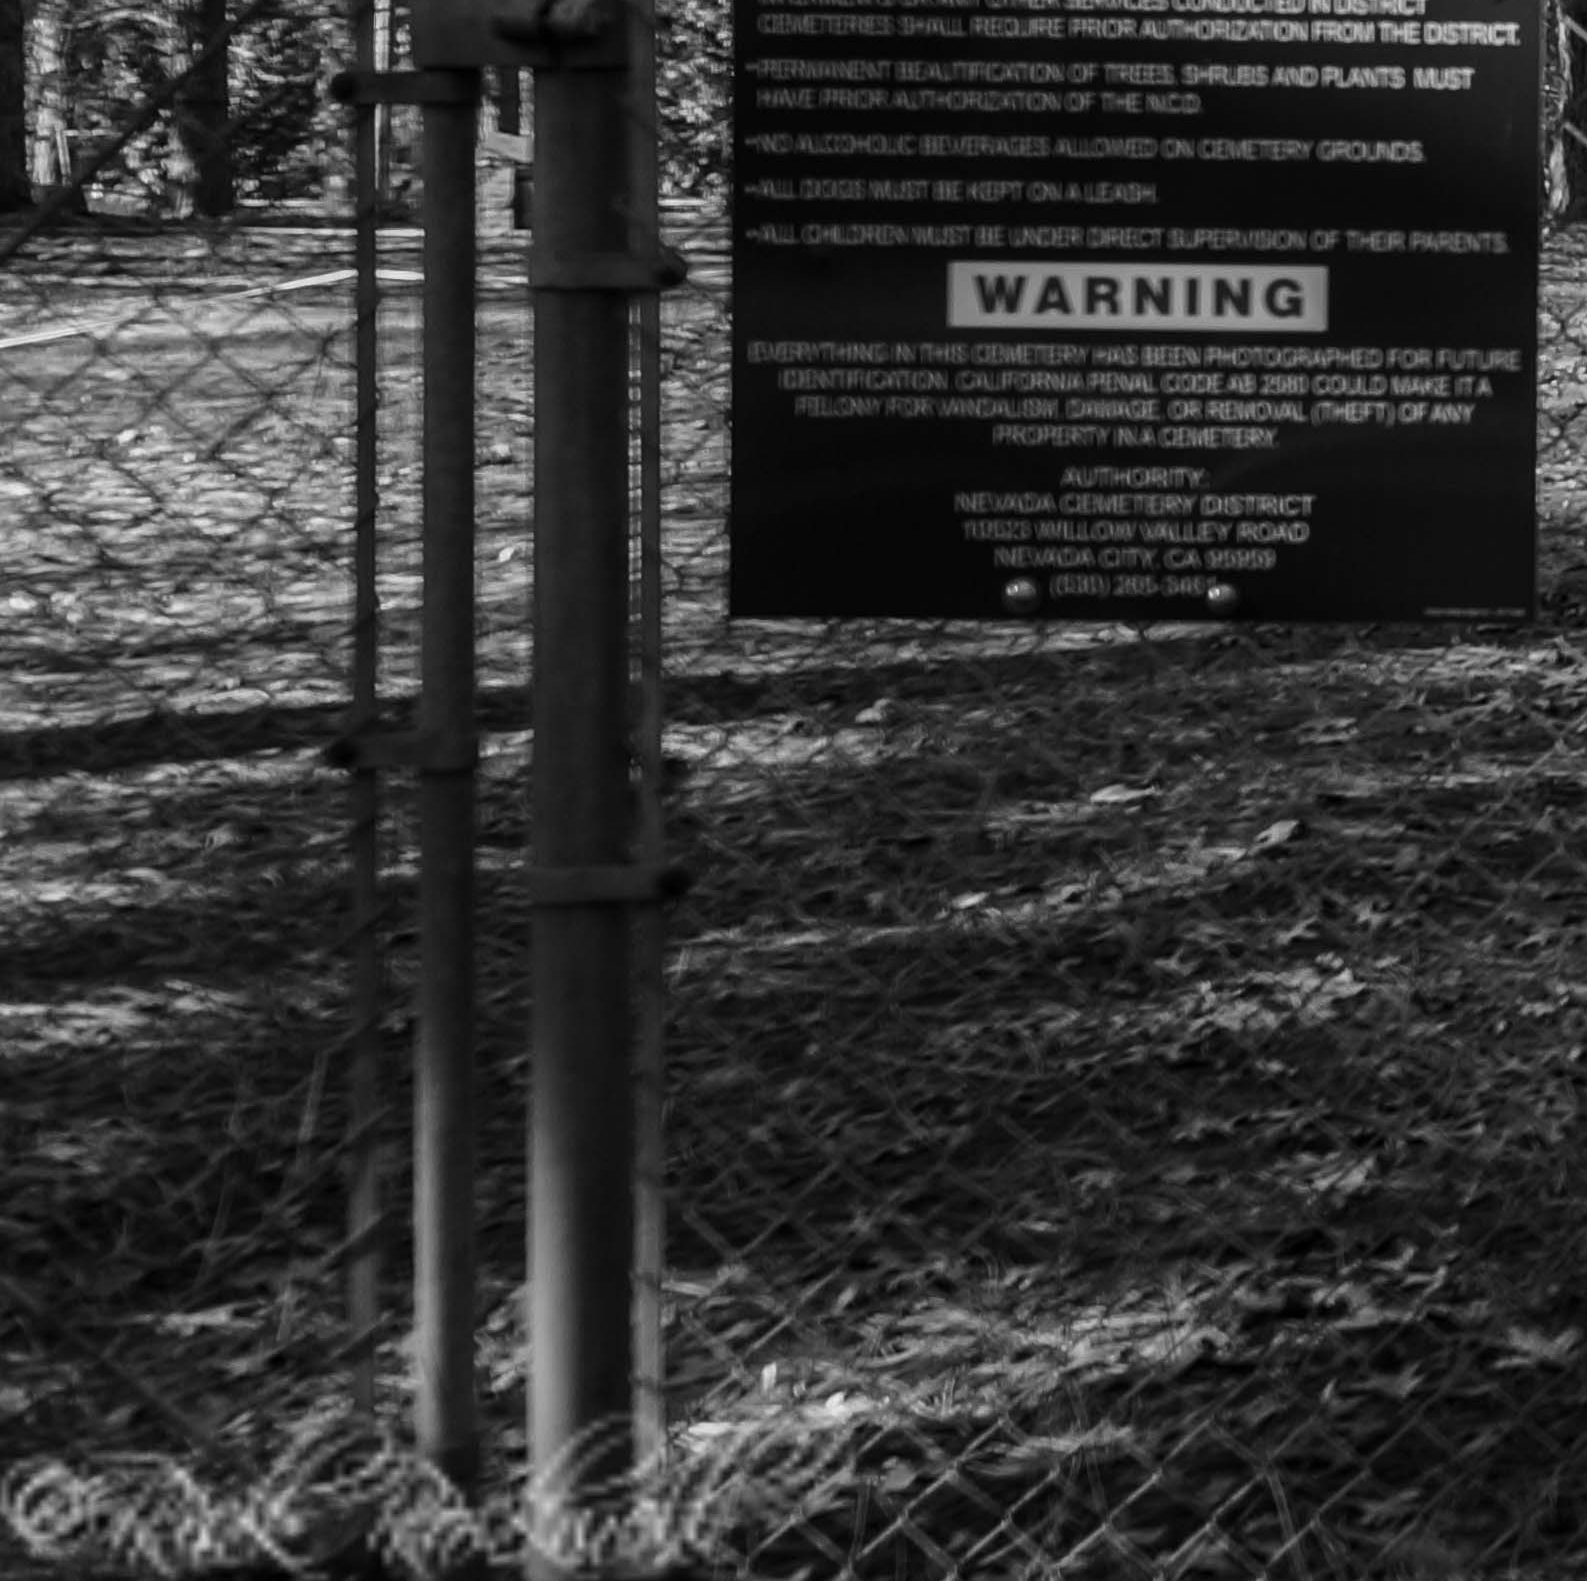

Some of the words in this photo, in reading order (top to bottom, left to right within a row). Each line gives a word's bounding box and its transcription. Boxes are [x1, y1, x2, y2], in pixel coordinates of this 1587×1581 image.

[756, 14, 895, 35] CEMETERIES
[896, 15, 966, 37] SHALL
[969, 16, 1067, 38] REQUIRE
[1068, 17, 1138, 39] PRIOR
[1138, 19, 1309, 41] AUTHORIZATION
[1310, 20, 1376, 43] FROM
[1378, 21, 1423, 44] THE
[895, 61, 1063, 82] BEAUTIFICATION
[1065, 62, 1097, 84] OF
[1179, 64, 1270, 86] SHRUBS
[1271, 65, 1319, 87] AND
[1320, 66, 1406, 88] PLANTS
[1412, 67, 1476, 90] MUST
[755, 87, 819, 108] HAVE
[818, 88, 891, 109] PRIOR
[890, 90, 1063, 111] AUTHORIZATION
[1063, 91, 1097, 113] OF
[1100, 91, 1144, 113] THE
[793, 134, 918, 155] ALCOHOLIC
[919, 135, 1051, 157] BEVERAGES
[1054, 137, 1159, 158] ALLOWED
[1160, 138, 1196, 159] ON
[1196, 139, 1314, 160] CEMETERY
[799, 179, 865, 200] DOGS
[867, 179, 931, 201] MUST
[932, 180, 963, 201] BE
[966, 181, 1024, 202] KEPT
[1025, 181, 1063, 202] ON
[1064, 182, 1082, 203] A
[800, 224, 910, 246] CHILDREN
[910, 225, 973, 247] MUST
[974, 225, 1007, 247] BE
[1008, 226, 1083, 248] UNDER
[1085, 227, 1165, 249] DIRECT
[1165, 228, 1307, 250] SUPERVISION
[1309, 229, 1341, 251] OF
[1344, 230, 1408, 252] THEIR
[973, 273, 1306, 318] WARNING
[746, 341, 891, 362] EVERYTHING
[892, 342, 917, 363] IN
[918, 342, 970, 364] THIS
[970, 343, 1087, 365] CEMETERY
[1090, 344, 1139, 366] HAS
[1141, 345, 1201, 367] BEEN
[1203, 346, 1384, 368] PHOTOGRAPHED
[1385, 348, 1434, 370] FOR
[1435, 348, 1522, 371] FUTURE
[953, 370, 1089, 392] CALIFORNIA
[1088, 371, 1159, 393] PENAL
[1160, 372, 1226, 394] CODE
[1310, 374, 1388, 396] COULD
[1389, 375, 1452, 397] MAKE
[1453, 376, 1475, 397] IT
[1474, 376, 1494, 397] A
[793, 395, 880, 417] FELONY
[884, 396, 935, 418] FOR
[1166, 399, 1204, 421] OR
[1205, 400, 1308, 422] REMOVAL
[1310, 401, 1396, 423] (THEFT)
[1396, 402, 1428, 423] OF
[1428, 402, 1477, 424] ANY
[992, 425, 1110, 445] PROPERTY
[1112, 426, 1137, 446] IN
[1136, 426, 1157, 446] A
[953, 493, 1056, 515] NEVADA
[1057, 493, 1198, 515] CEMETERY
[1199, 493, 1318, 515] DISTRICT
[1033, 520, 1138, 542] WILLOW
[1137, 521, 1234, 542] VALLEY
[1235, 521, 1311, 543] ROAD
[992, 546, 1096, 567] NEVADA
[1162, 547, 1203, 569] CA
